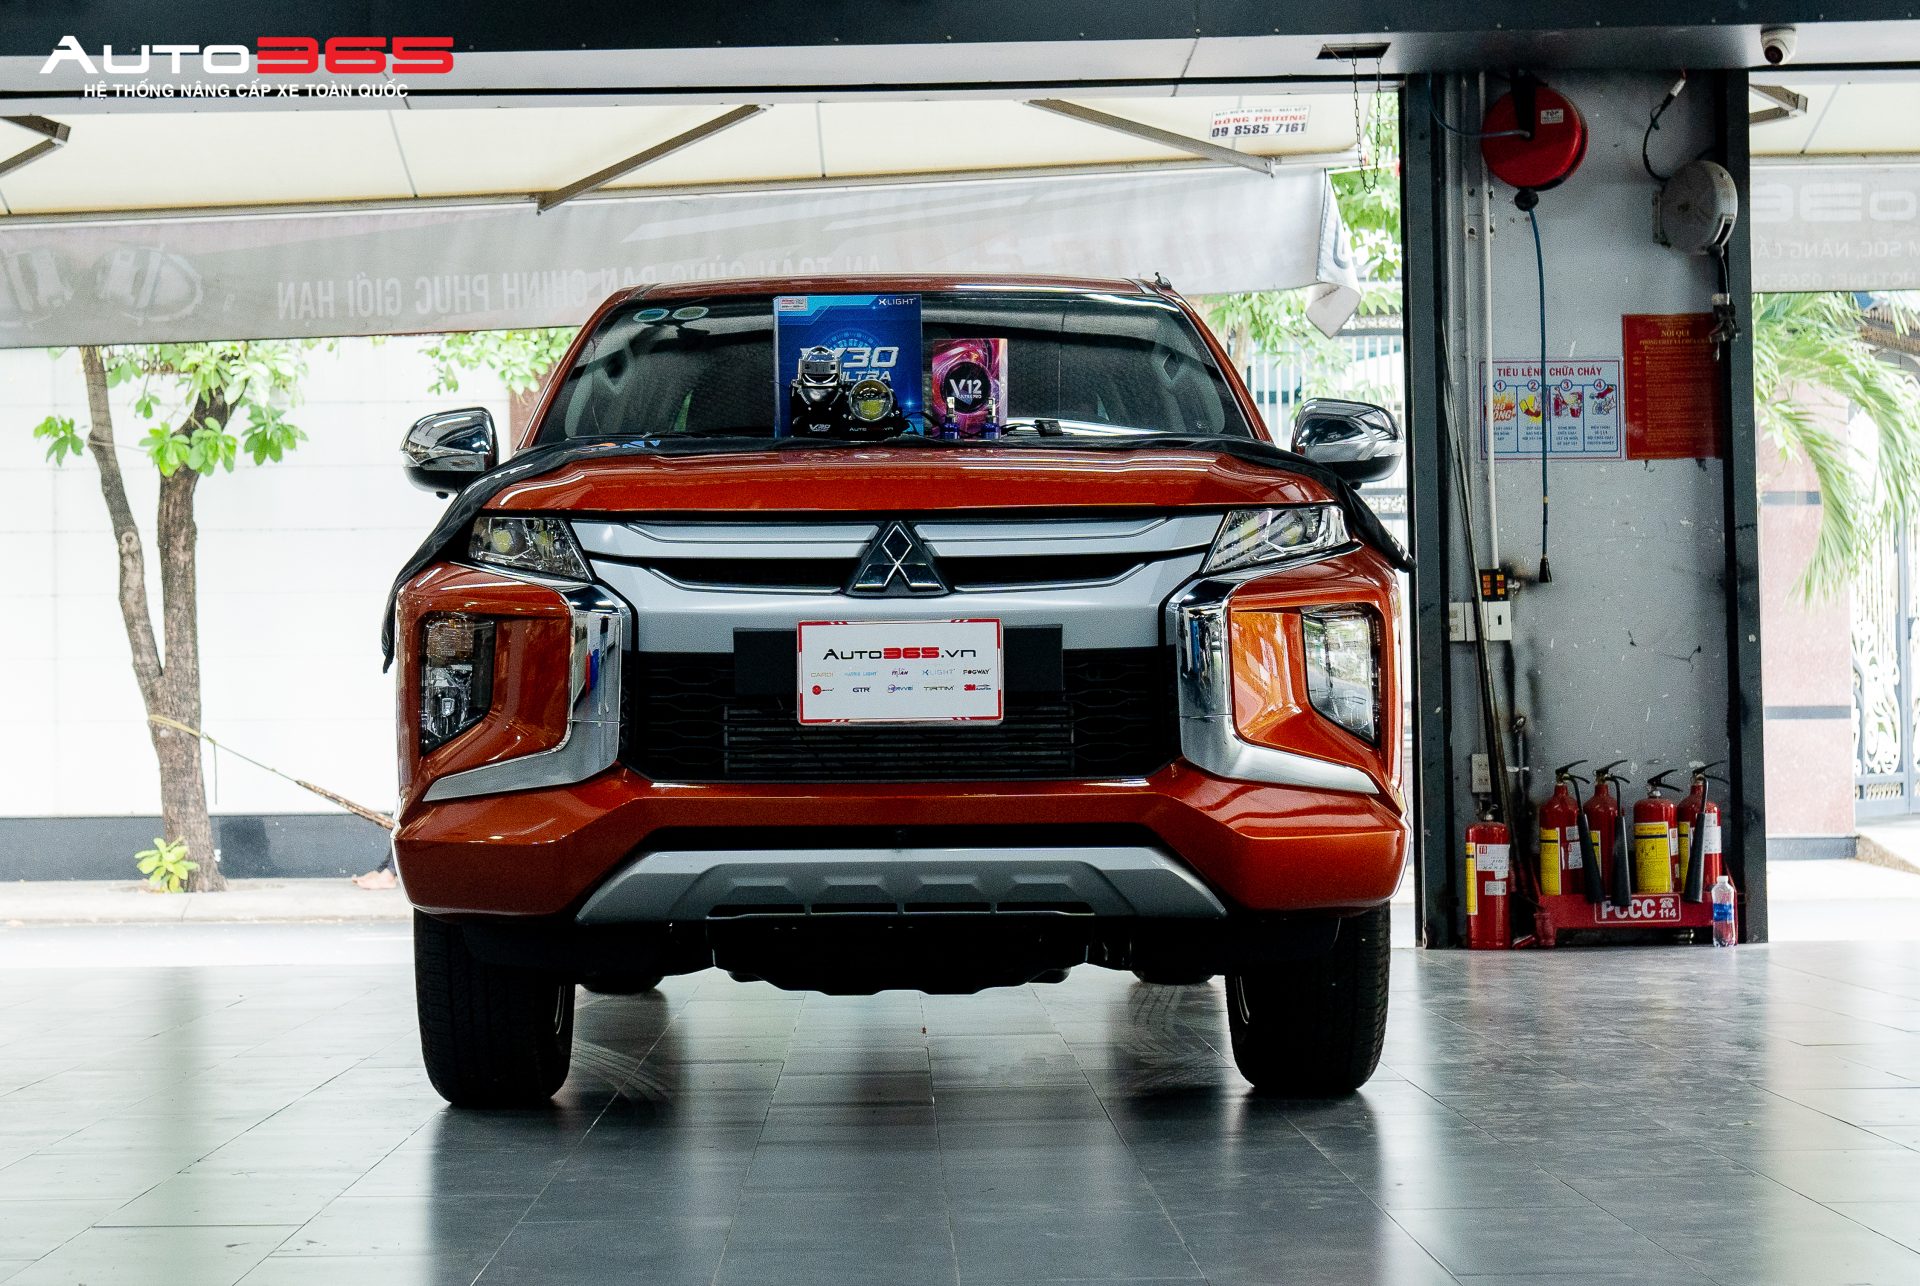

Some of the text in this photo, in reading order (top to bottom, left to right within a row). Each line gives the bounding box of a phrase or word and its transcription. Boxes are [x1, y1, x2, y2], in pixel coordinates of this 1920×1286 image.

[1211, 122, 1306, 138] 09 8585 7161
[1522, 367, 1546, 378] LỆN
[1549, 365, 1575, 376] CHỮA
[1577, 365, 1603, 376] CHÁY
[949, 379, 982, 398] V12
[1658, 908, 1676, 918] 114
